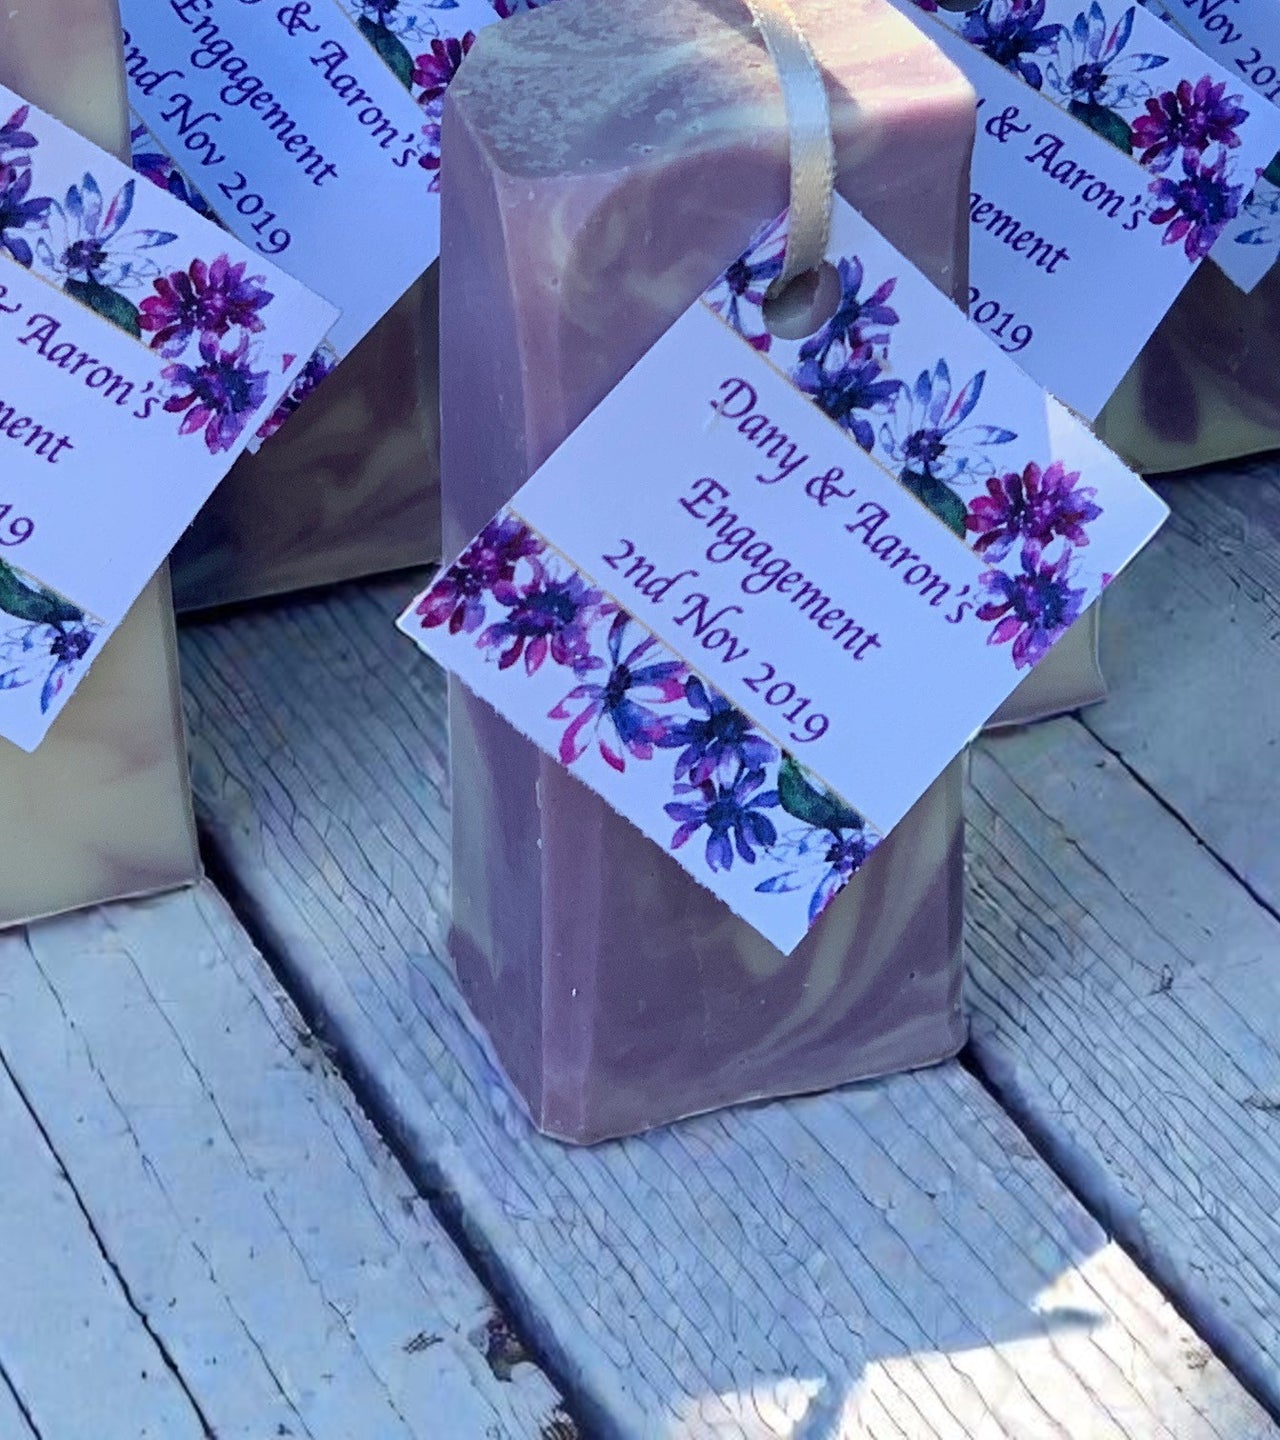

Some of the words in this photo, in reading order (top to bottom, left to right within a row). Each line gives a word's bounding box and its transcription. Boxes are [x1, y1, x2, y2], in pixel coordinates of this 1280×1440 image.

[277, 1, 320, 36] &
[310, 40, 420, 168] Aaron's
[161, 93, 225, 168] Nov
[218, 171, 292, 256] 2019
[970, 193, 1070, 274] ement
[985, 107, 1031, 142] &
[1024, 133, 1149, 230] Aaron's
[18, 314, 165, 420] Aaron's
[679, 477, 885, 661] Engagement
[710, 377, 808, 484] Dany
[805, 468, 856, 506] &
[846, 502, 978, 624] Aaron's
[603, 539, 693, 605] 2nd
[674, 593, 750, 662] Nov
[743, 662, 829, 743] 2019
